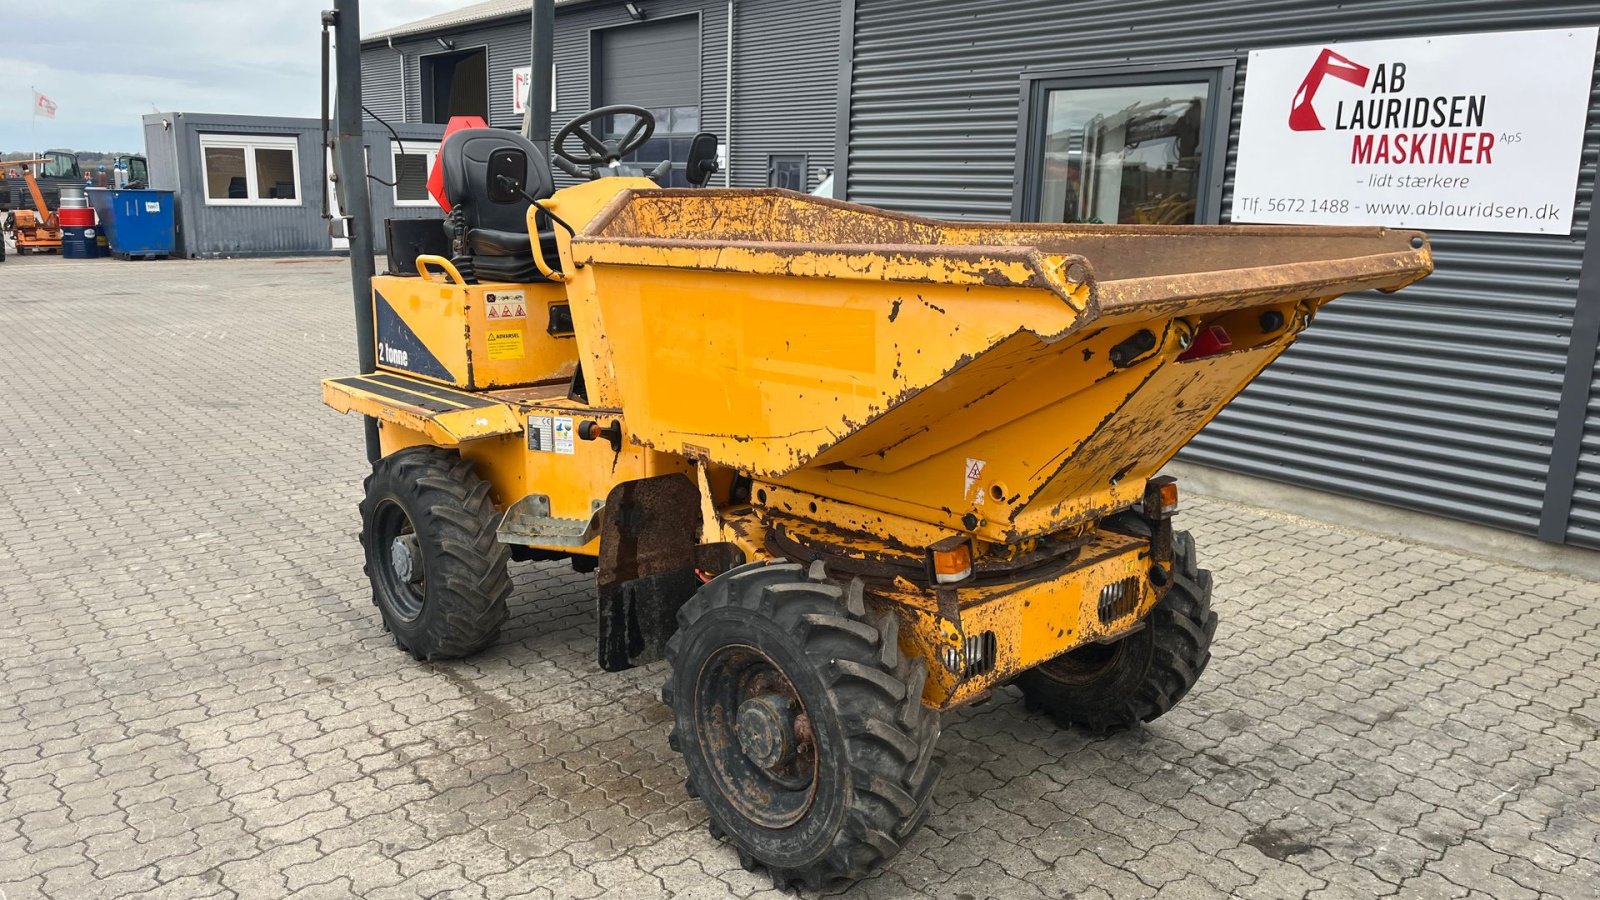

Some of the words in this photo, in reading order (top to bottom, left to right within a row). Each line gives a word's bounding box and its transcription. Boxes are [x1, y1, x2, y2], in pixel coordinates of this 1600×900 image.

[1371, 62, 1407, 94] AB
[1335, 95, 1487, 130] LAURIDSEN
[1351, 132, 1495, 165] MASKINER
[1499, 132, 1522, 145] ApS
[1368, 173, 1394, 188] lidt
[1397, 173, 1470, 189] stærkere
[1241, 197, 1263, 215] Tlf.
[1267, 198, 1305, 213] 5672
[1310, 199, 1349, 214] 1488
[1366, 200, 1560, 221] www.ablauridsen.dk
[379, 342, 384, 362] 2
[385, 343, 408, 367] tonne
